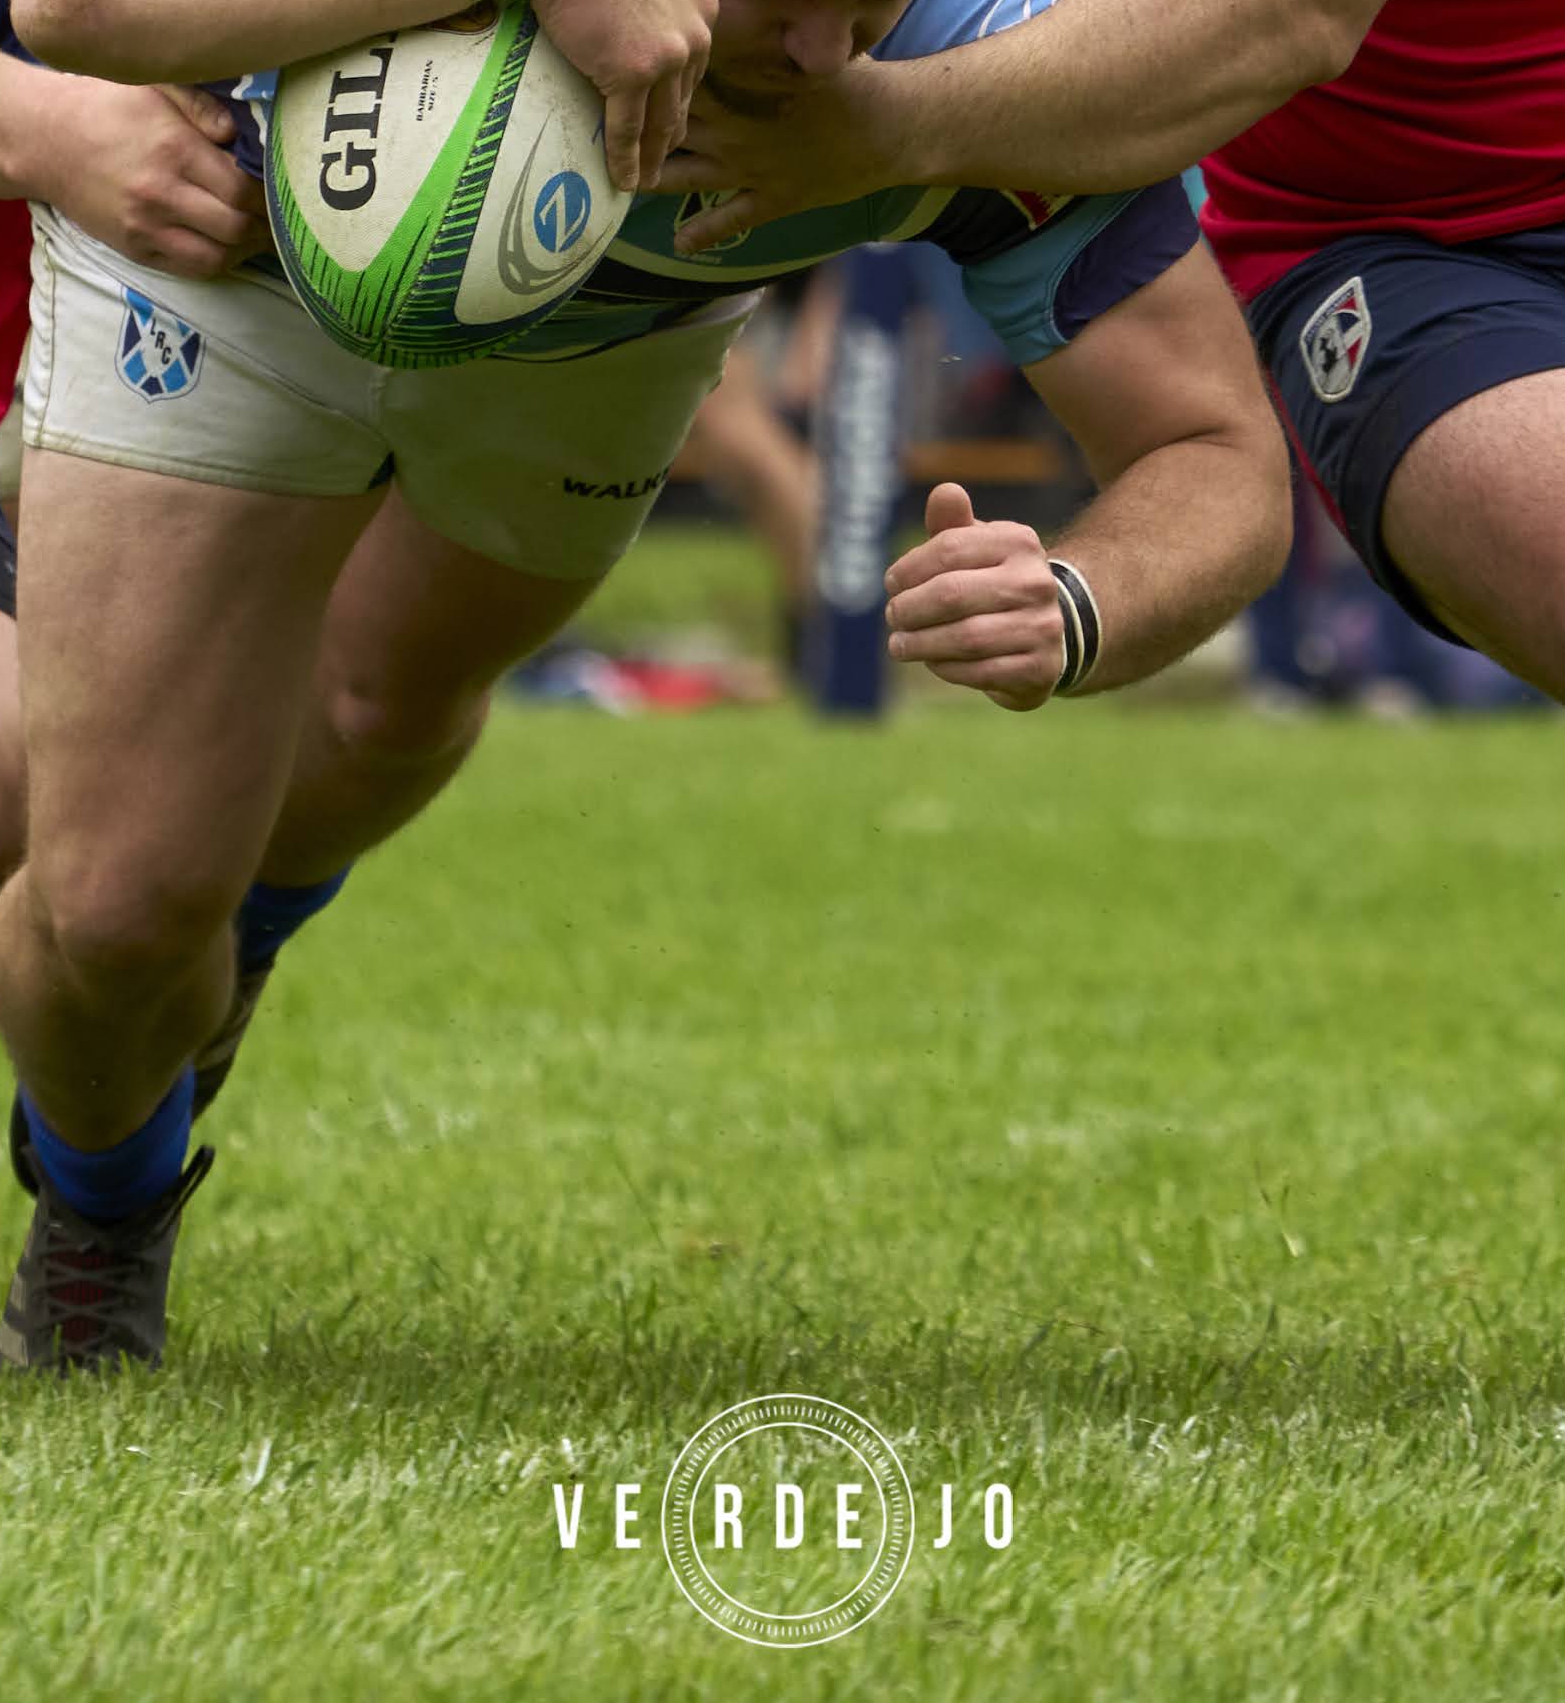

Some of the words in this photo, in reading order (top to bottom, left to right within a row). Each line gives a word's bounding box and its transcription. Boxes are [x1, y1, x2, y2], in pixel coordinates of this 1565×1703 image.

[319, 32, 399, 211] GIL
[415, 59, 434, 122] BARBARIAN
[150, 316, 172, 366] LRC
